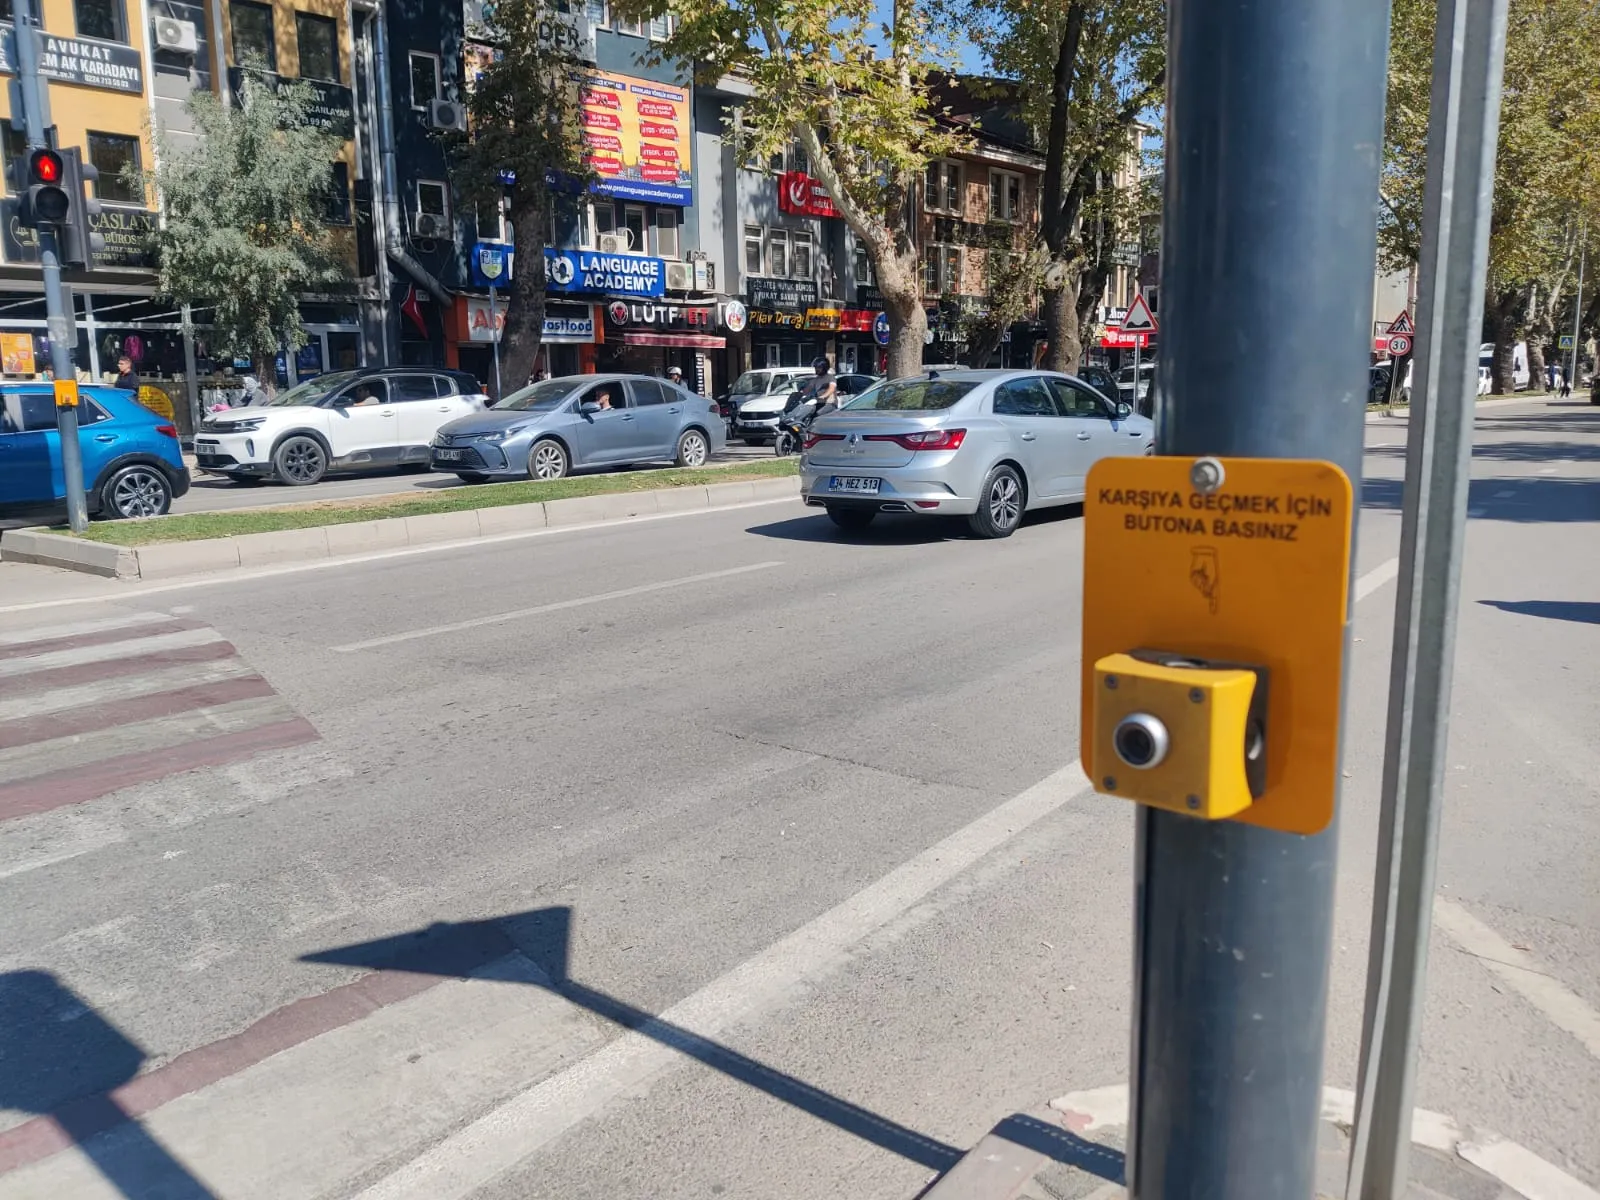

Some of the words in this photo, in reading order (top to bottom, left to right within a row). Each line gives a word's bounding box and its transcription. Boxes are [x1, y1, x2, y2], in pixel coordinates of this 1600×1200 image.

[47, 38, 111, 60] AVUKAT
[61, 55, 77, 71] AK
[80, 58, 138, 81] KARADAYI
[580, 255, 659, 277] LANGUAGE
[583, 275, 657, 292] ACADEMY
[749, 310, 774, 324] Pilav
[1392, 340, 1406, 350] 30
[834, 478, 843, 489] 34
[846, 478, 860, 489] HEZ
[862, 479, 878, 490] 513
[1099, 489, 1182, 510] KARŞIYA
[1189, 491, 1280, 514] GEÇMEK
[1286, 492, 1331, 519] İÇİN
[1124, 514, 1207, 535] BUTONA
[1212, 520, 1298, 541] BASINIZ
